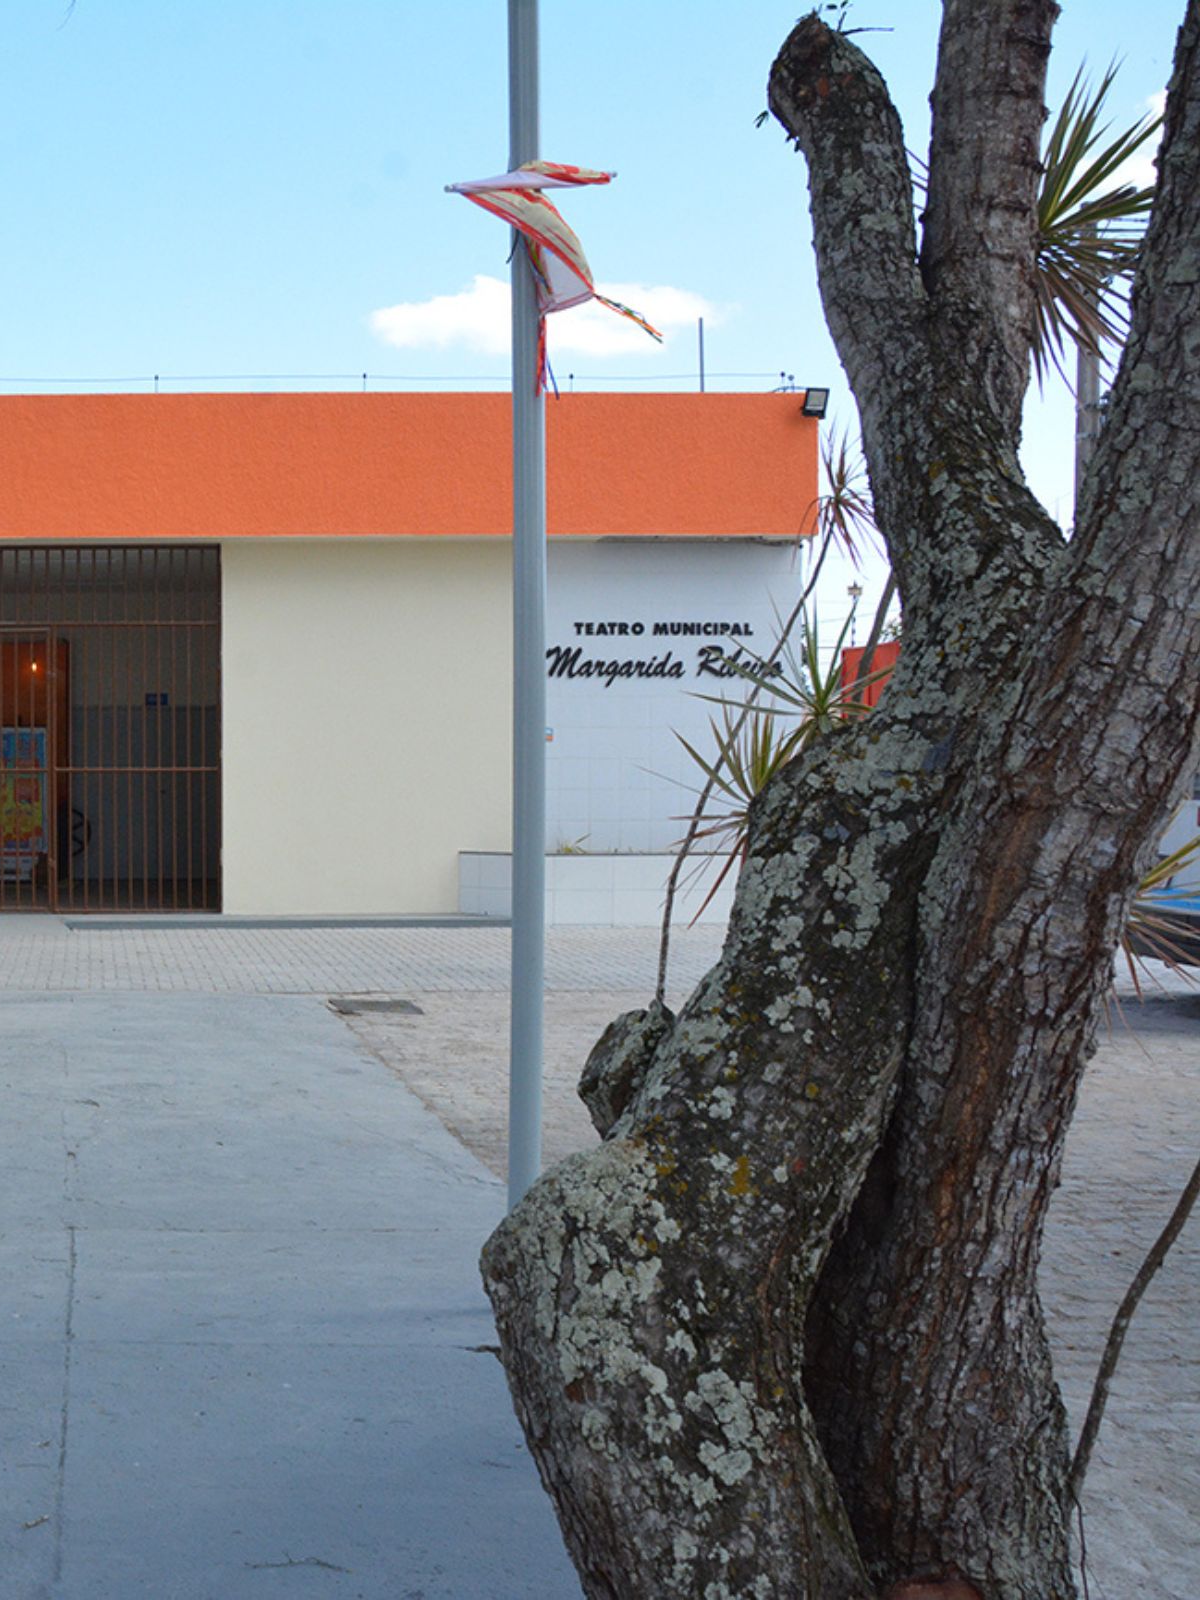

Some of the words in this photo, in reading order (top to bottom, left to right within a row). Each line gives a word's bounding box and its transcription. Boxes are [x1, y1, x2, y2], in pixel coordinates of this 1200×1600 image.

[573, 621, 645, 637] TEATRO
[652, 621, 754, 637] MUNICIPAL
[545, 645, 686, 688] Margarida
